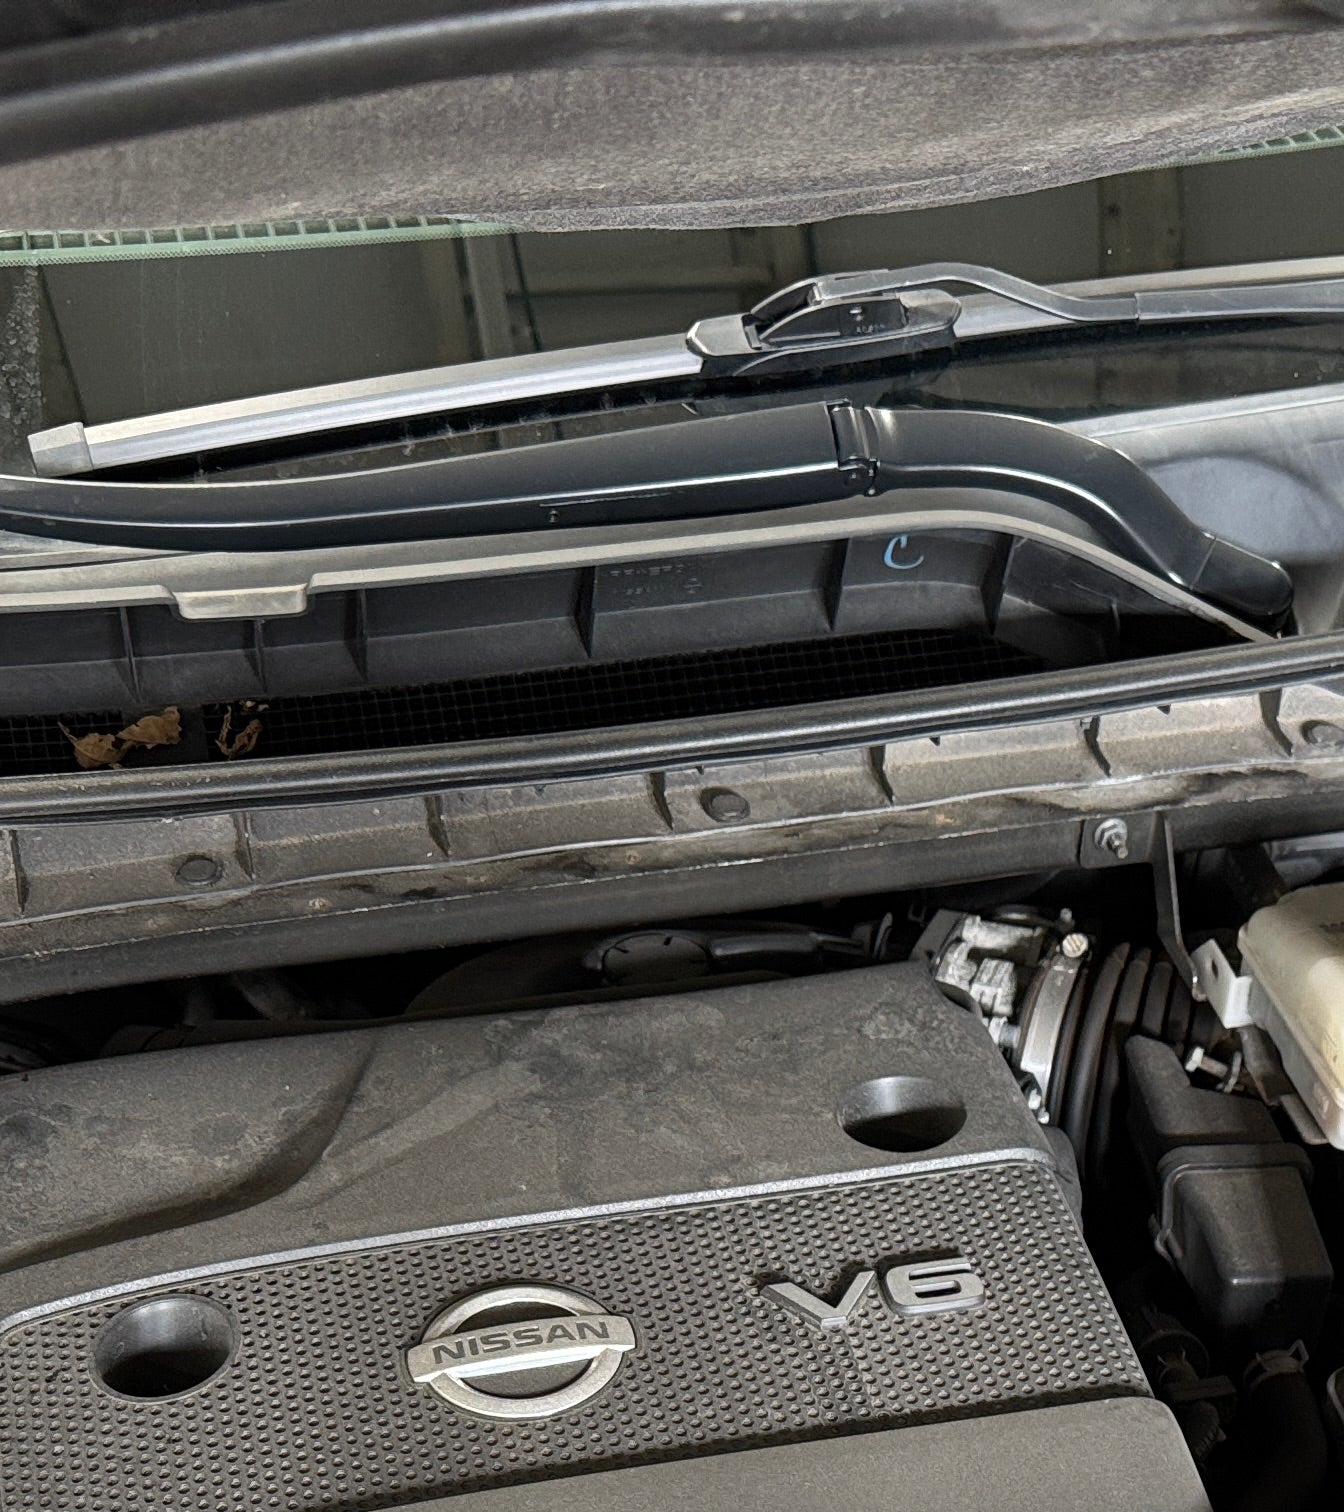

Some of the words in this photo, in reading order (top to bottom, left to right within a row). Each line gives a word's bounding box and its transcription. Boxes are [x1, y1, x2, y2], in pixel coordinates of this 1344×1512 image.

[884, 534, 925, 570] C
[762, 1256, 988, 1332] V6
[432, 1320, 609, 1366] NISSAN
